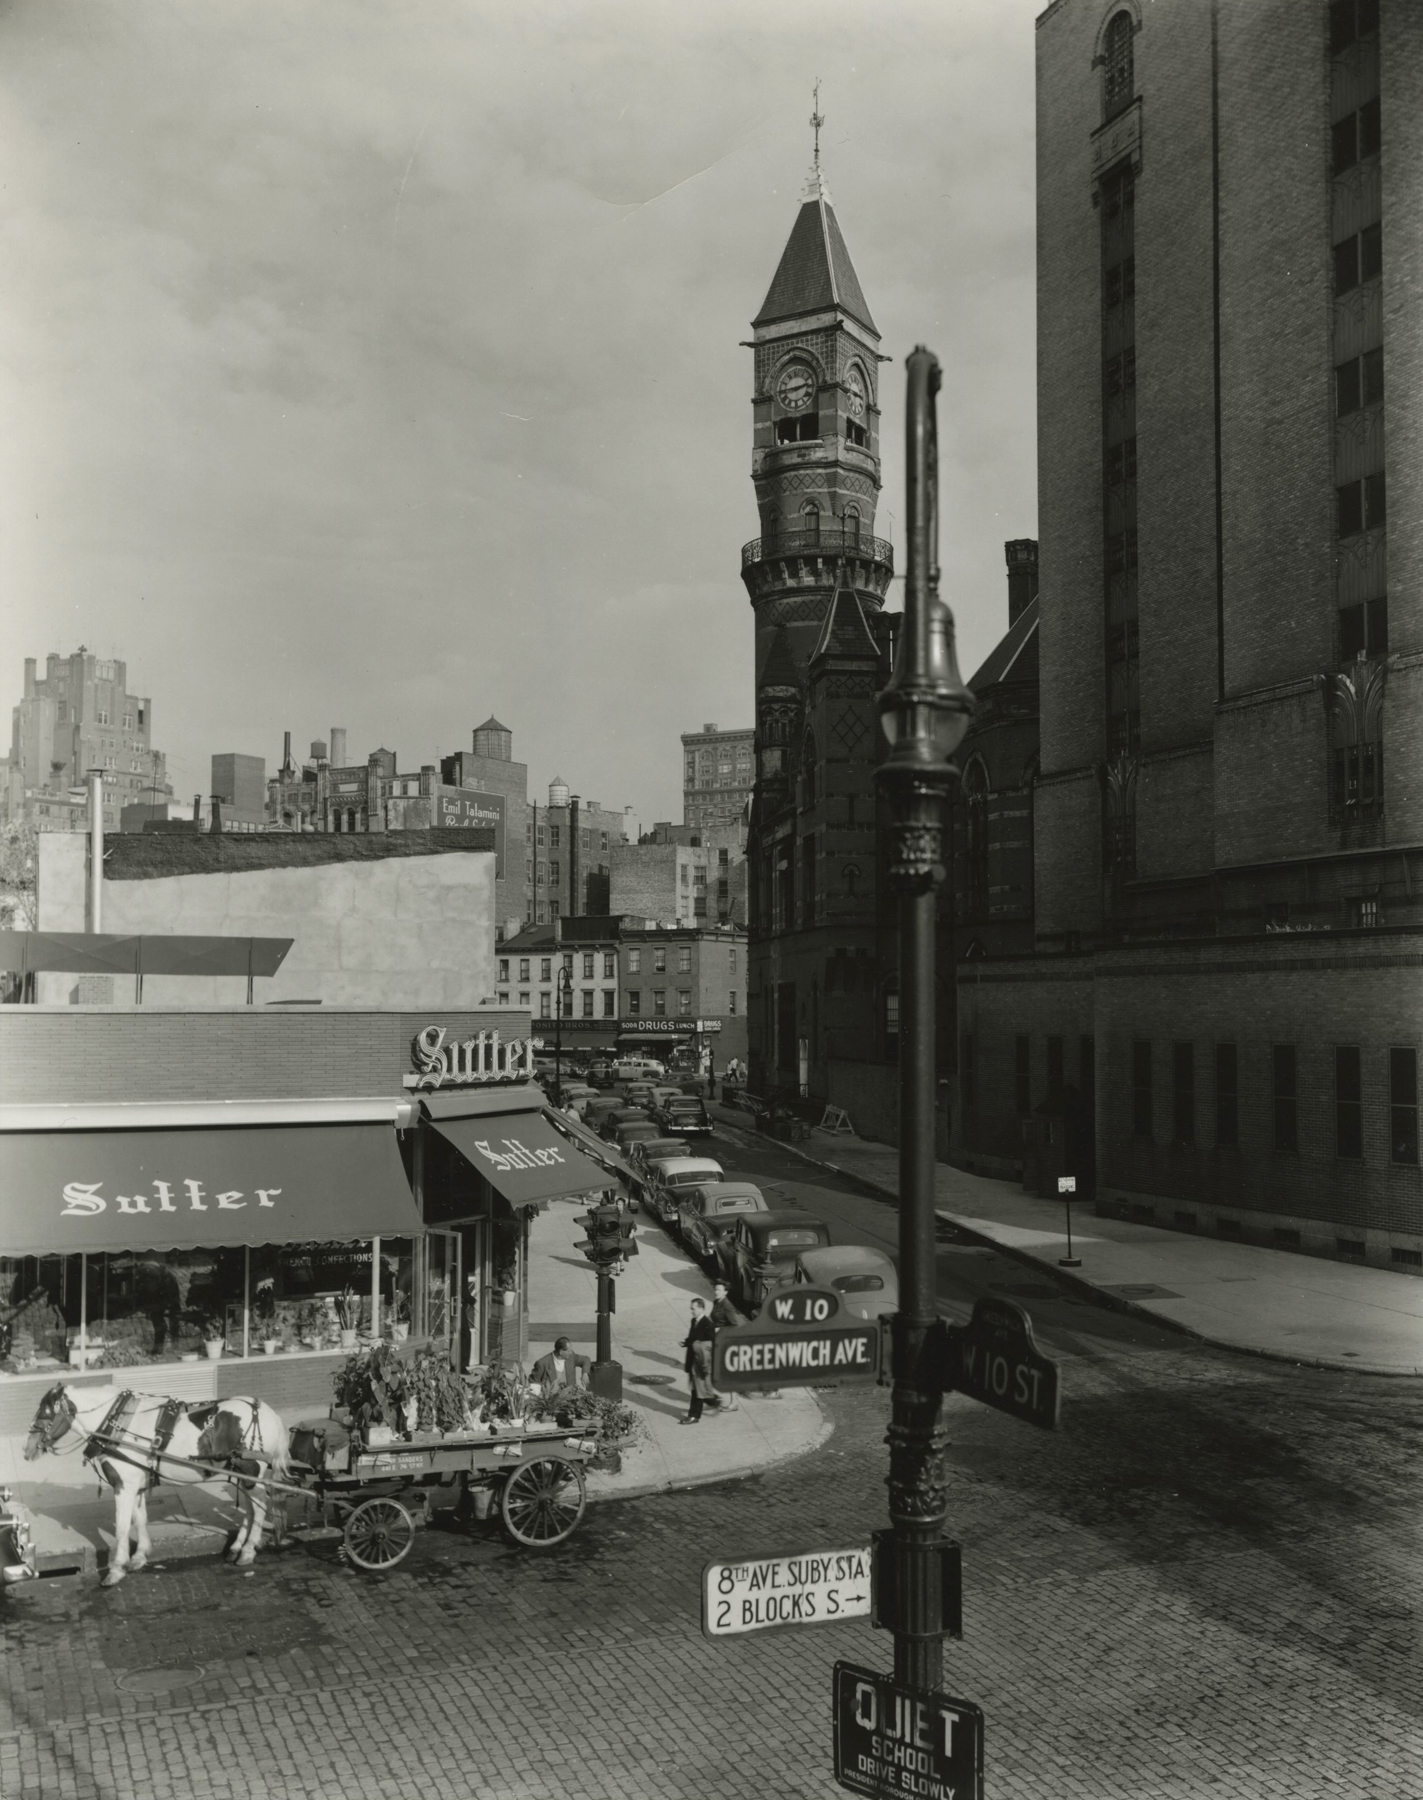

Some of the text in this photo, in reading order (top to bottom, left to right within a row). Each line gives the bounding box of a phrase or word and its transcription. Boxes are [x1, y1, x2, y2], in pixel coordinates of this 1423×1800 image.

[443, 798, 500, 820] Emil Talamini
[638, 1021, 675, 1030] DRUGS
[414, 1025, 545, 1088] Sutter
[474, 1138, 566, 1171] Sutter
[60, 1178, 283, 1216] Sutter
[775, 1298, 829, 1321] W. 10
[724, 1337, 871, 1372] GREENWICH AVE.
[984, 1351, 1008, 1396] 10
[716, 1589, 845, 1628] 2 BLOCKS S.
[871, 1735, 941, 1780] SCHOOL
[844, 1768, 878, 1788] PRESIDENT
[858, 1754, 956, 1800] DRIVE SLOWLY
